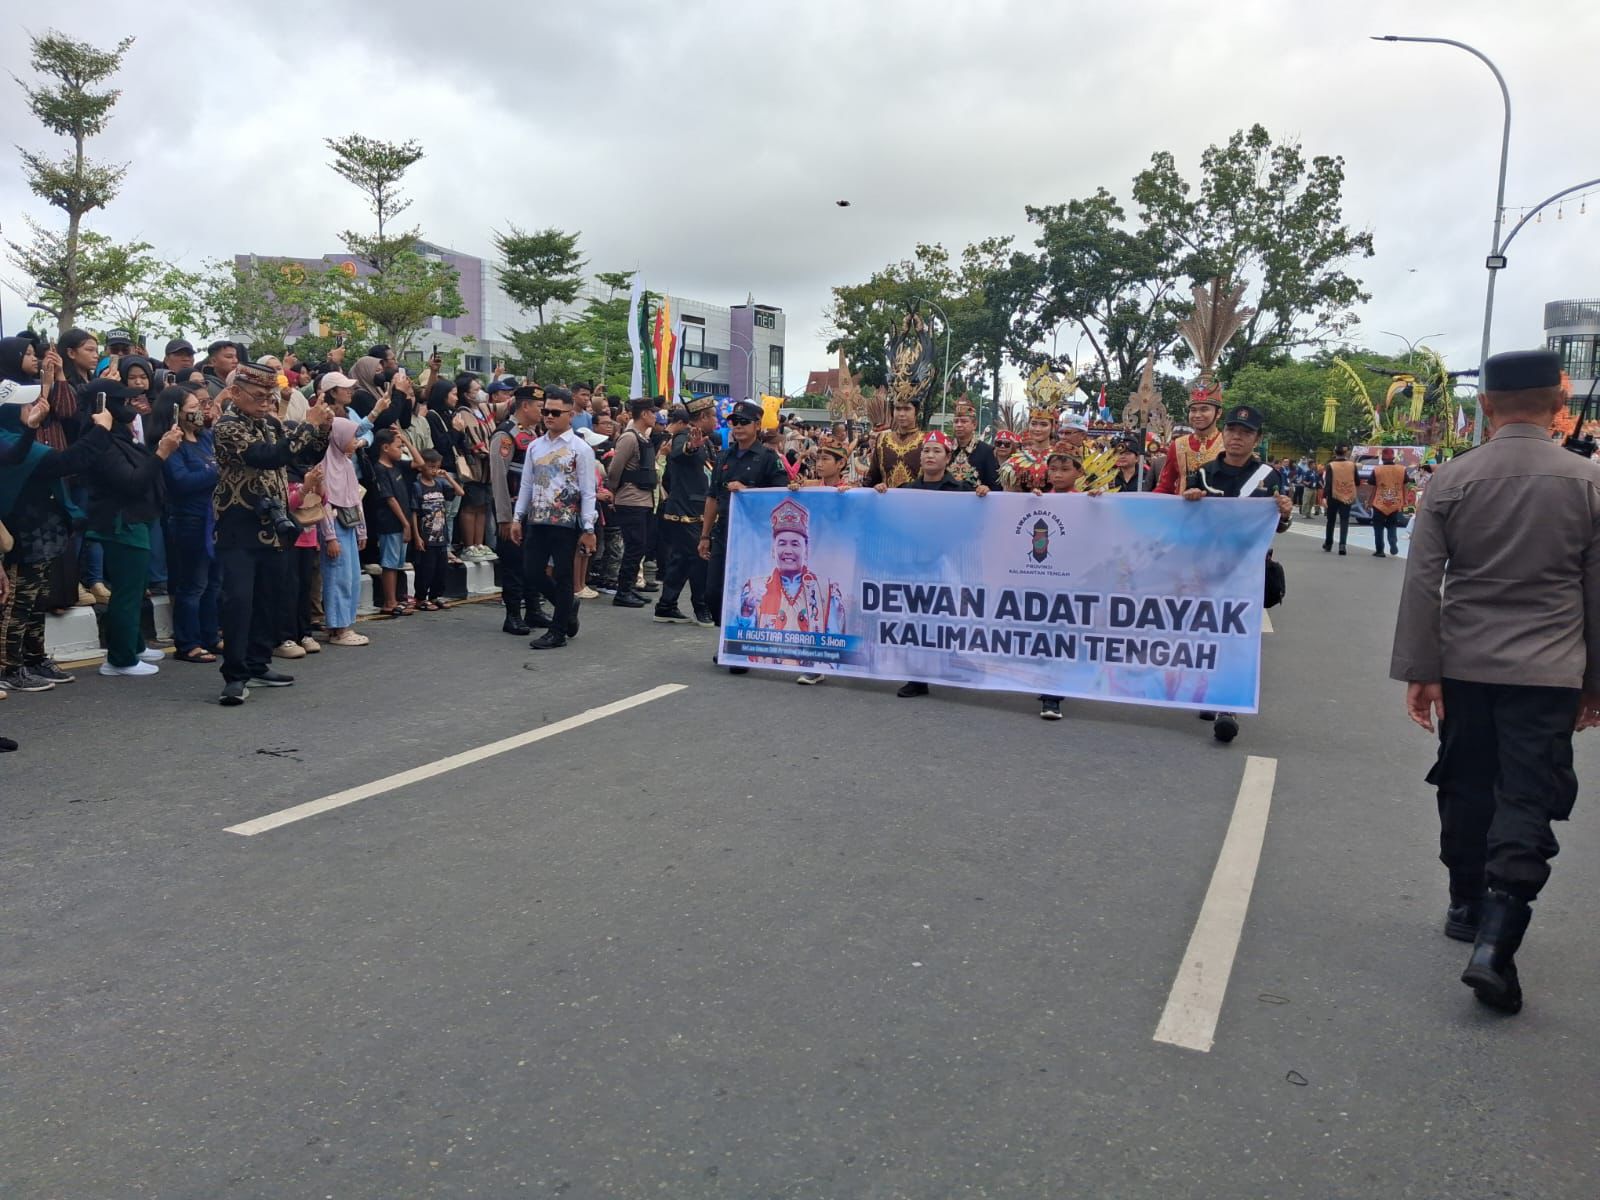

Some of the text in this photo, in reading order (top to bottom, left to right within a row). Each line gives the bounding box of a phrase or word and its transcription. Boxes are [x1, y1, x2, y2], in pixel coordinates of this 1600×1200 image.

[1015, 512, 1032, 535] DEWAN
[1051, 514, 1066, 536] DAYAK
[862, 581, 1250, 635] DEWAN ADAT DAYAK
[879, 621, 1076, 659] KALIMANTAN
[1085, 635, 1217, 670] TENGAH
